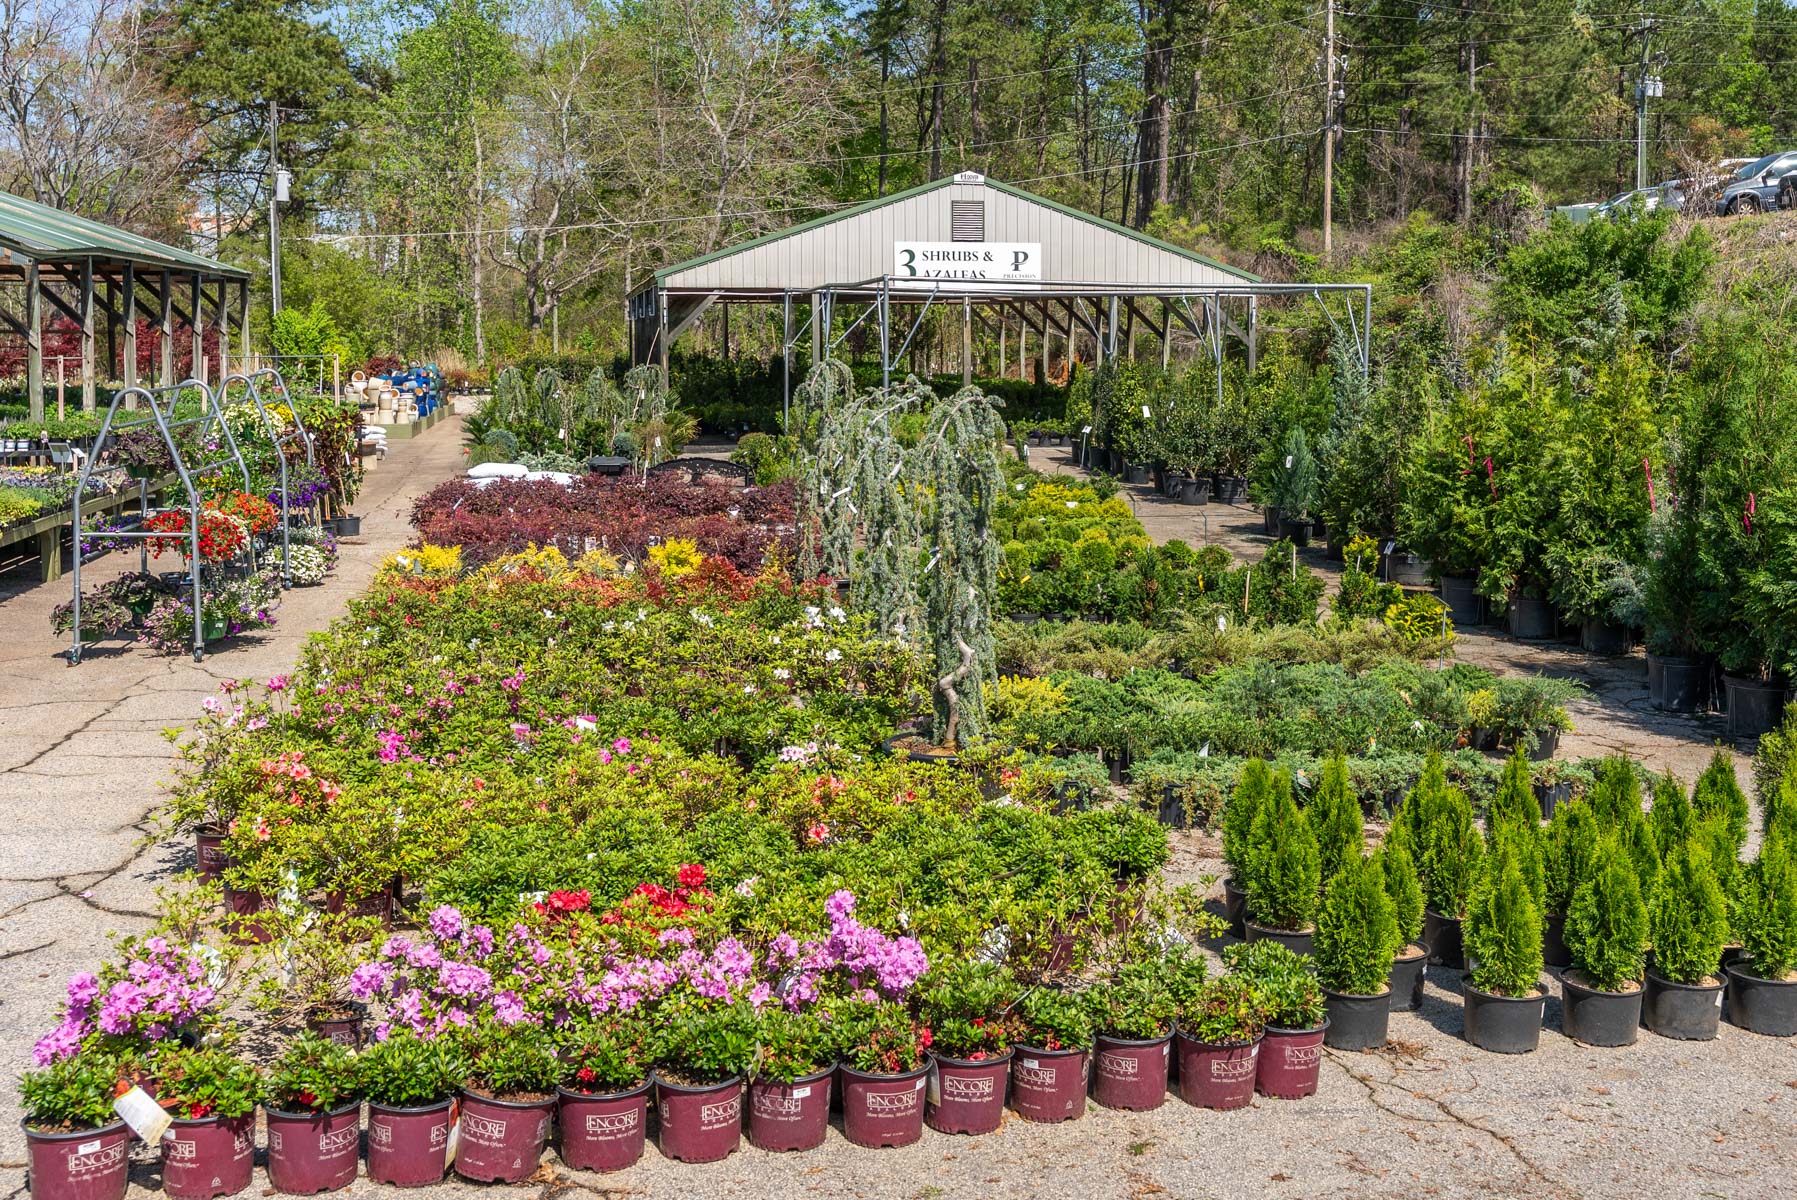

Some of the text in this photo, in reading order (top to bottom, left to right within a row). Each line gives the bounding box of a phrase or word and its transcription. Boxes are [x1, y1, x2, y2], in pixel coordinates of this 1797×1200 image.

[921, 250, 995, 262] SHRUBS &
[1010, 250, 1030, 272] P
[899, 248, 917, 281] 3
[923, 269, 987, 279] AZALEAS
[946, 1077, 992, 1093] ENCORE
[869, 1092, 915, 1107] ENCORE
[588, 1112, 637, 1129] ENCORE
[70, 1143, 124, 1170] ENCORE
